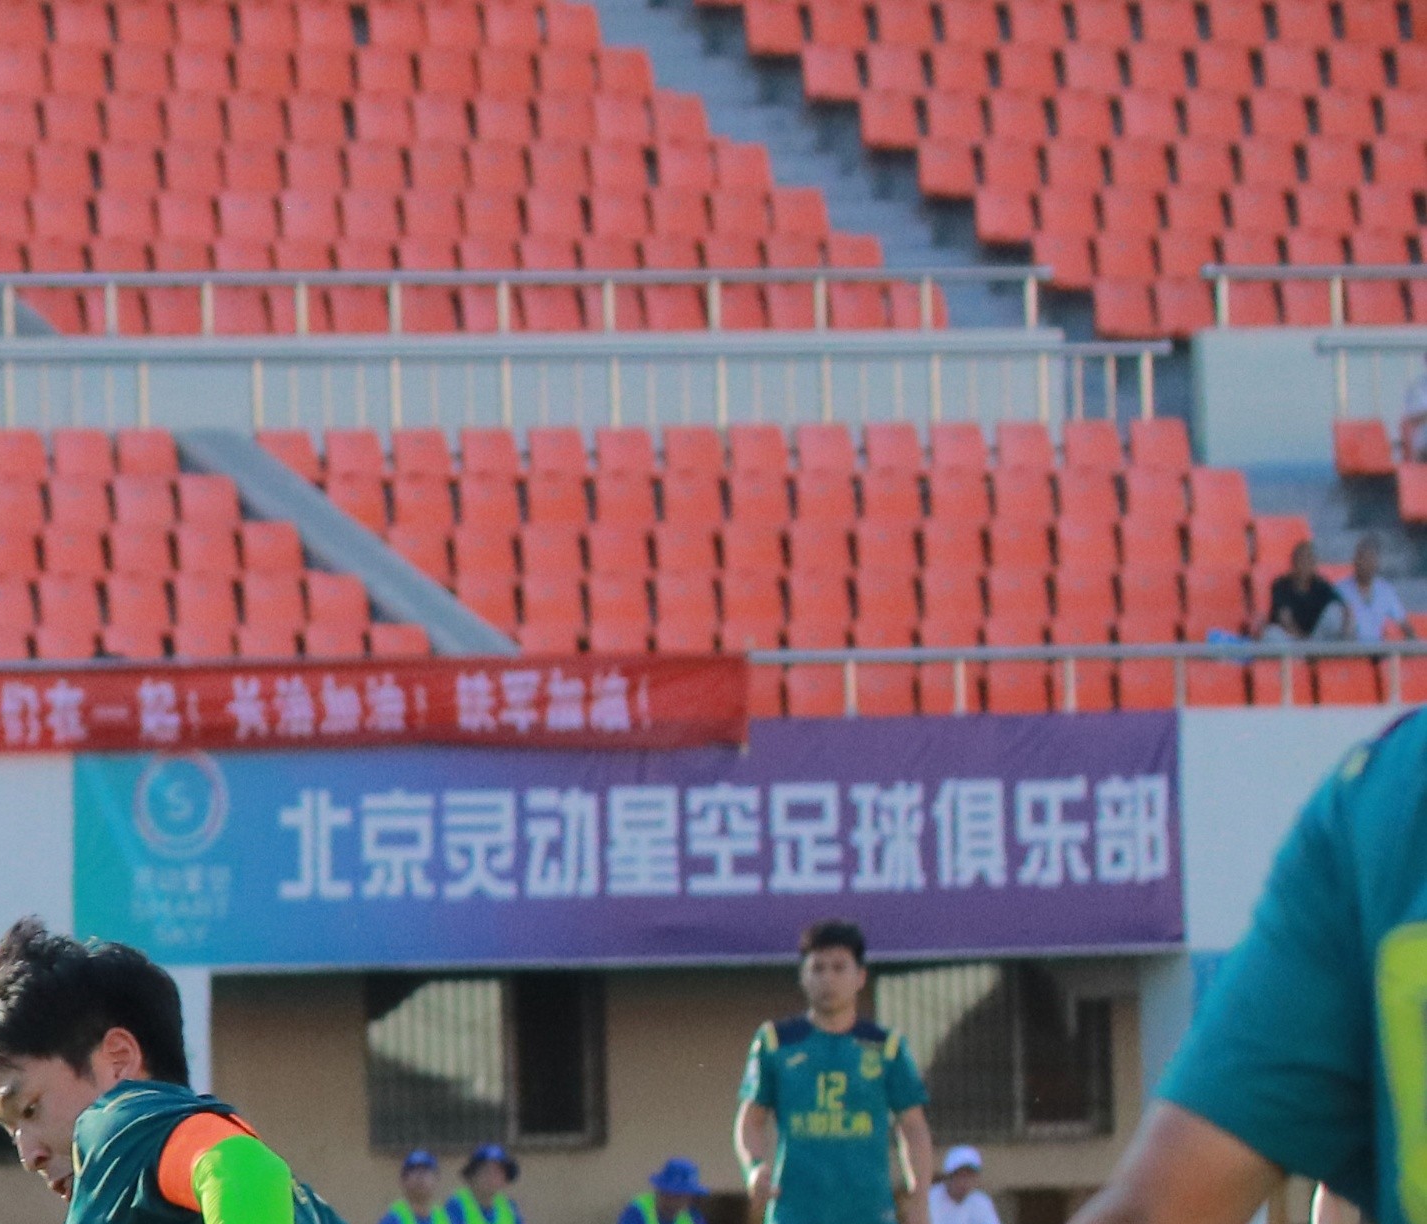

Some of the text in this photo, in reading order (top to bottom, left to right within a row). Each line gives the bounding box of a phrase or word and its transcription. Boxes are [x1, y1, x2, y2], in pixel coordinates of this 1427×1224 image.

[278, 772, 1171, 901] 北京灵动星空足球俱乐部
[815, 1070, 848, 1111] 12
